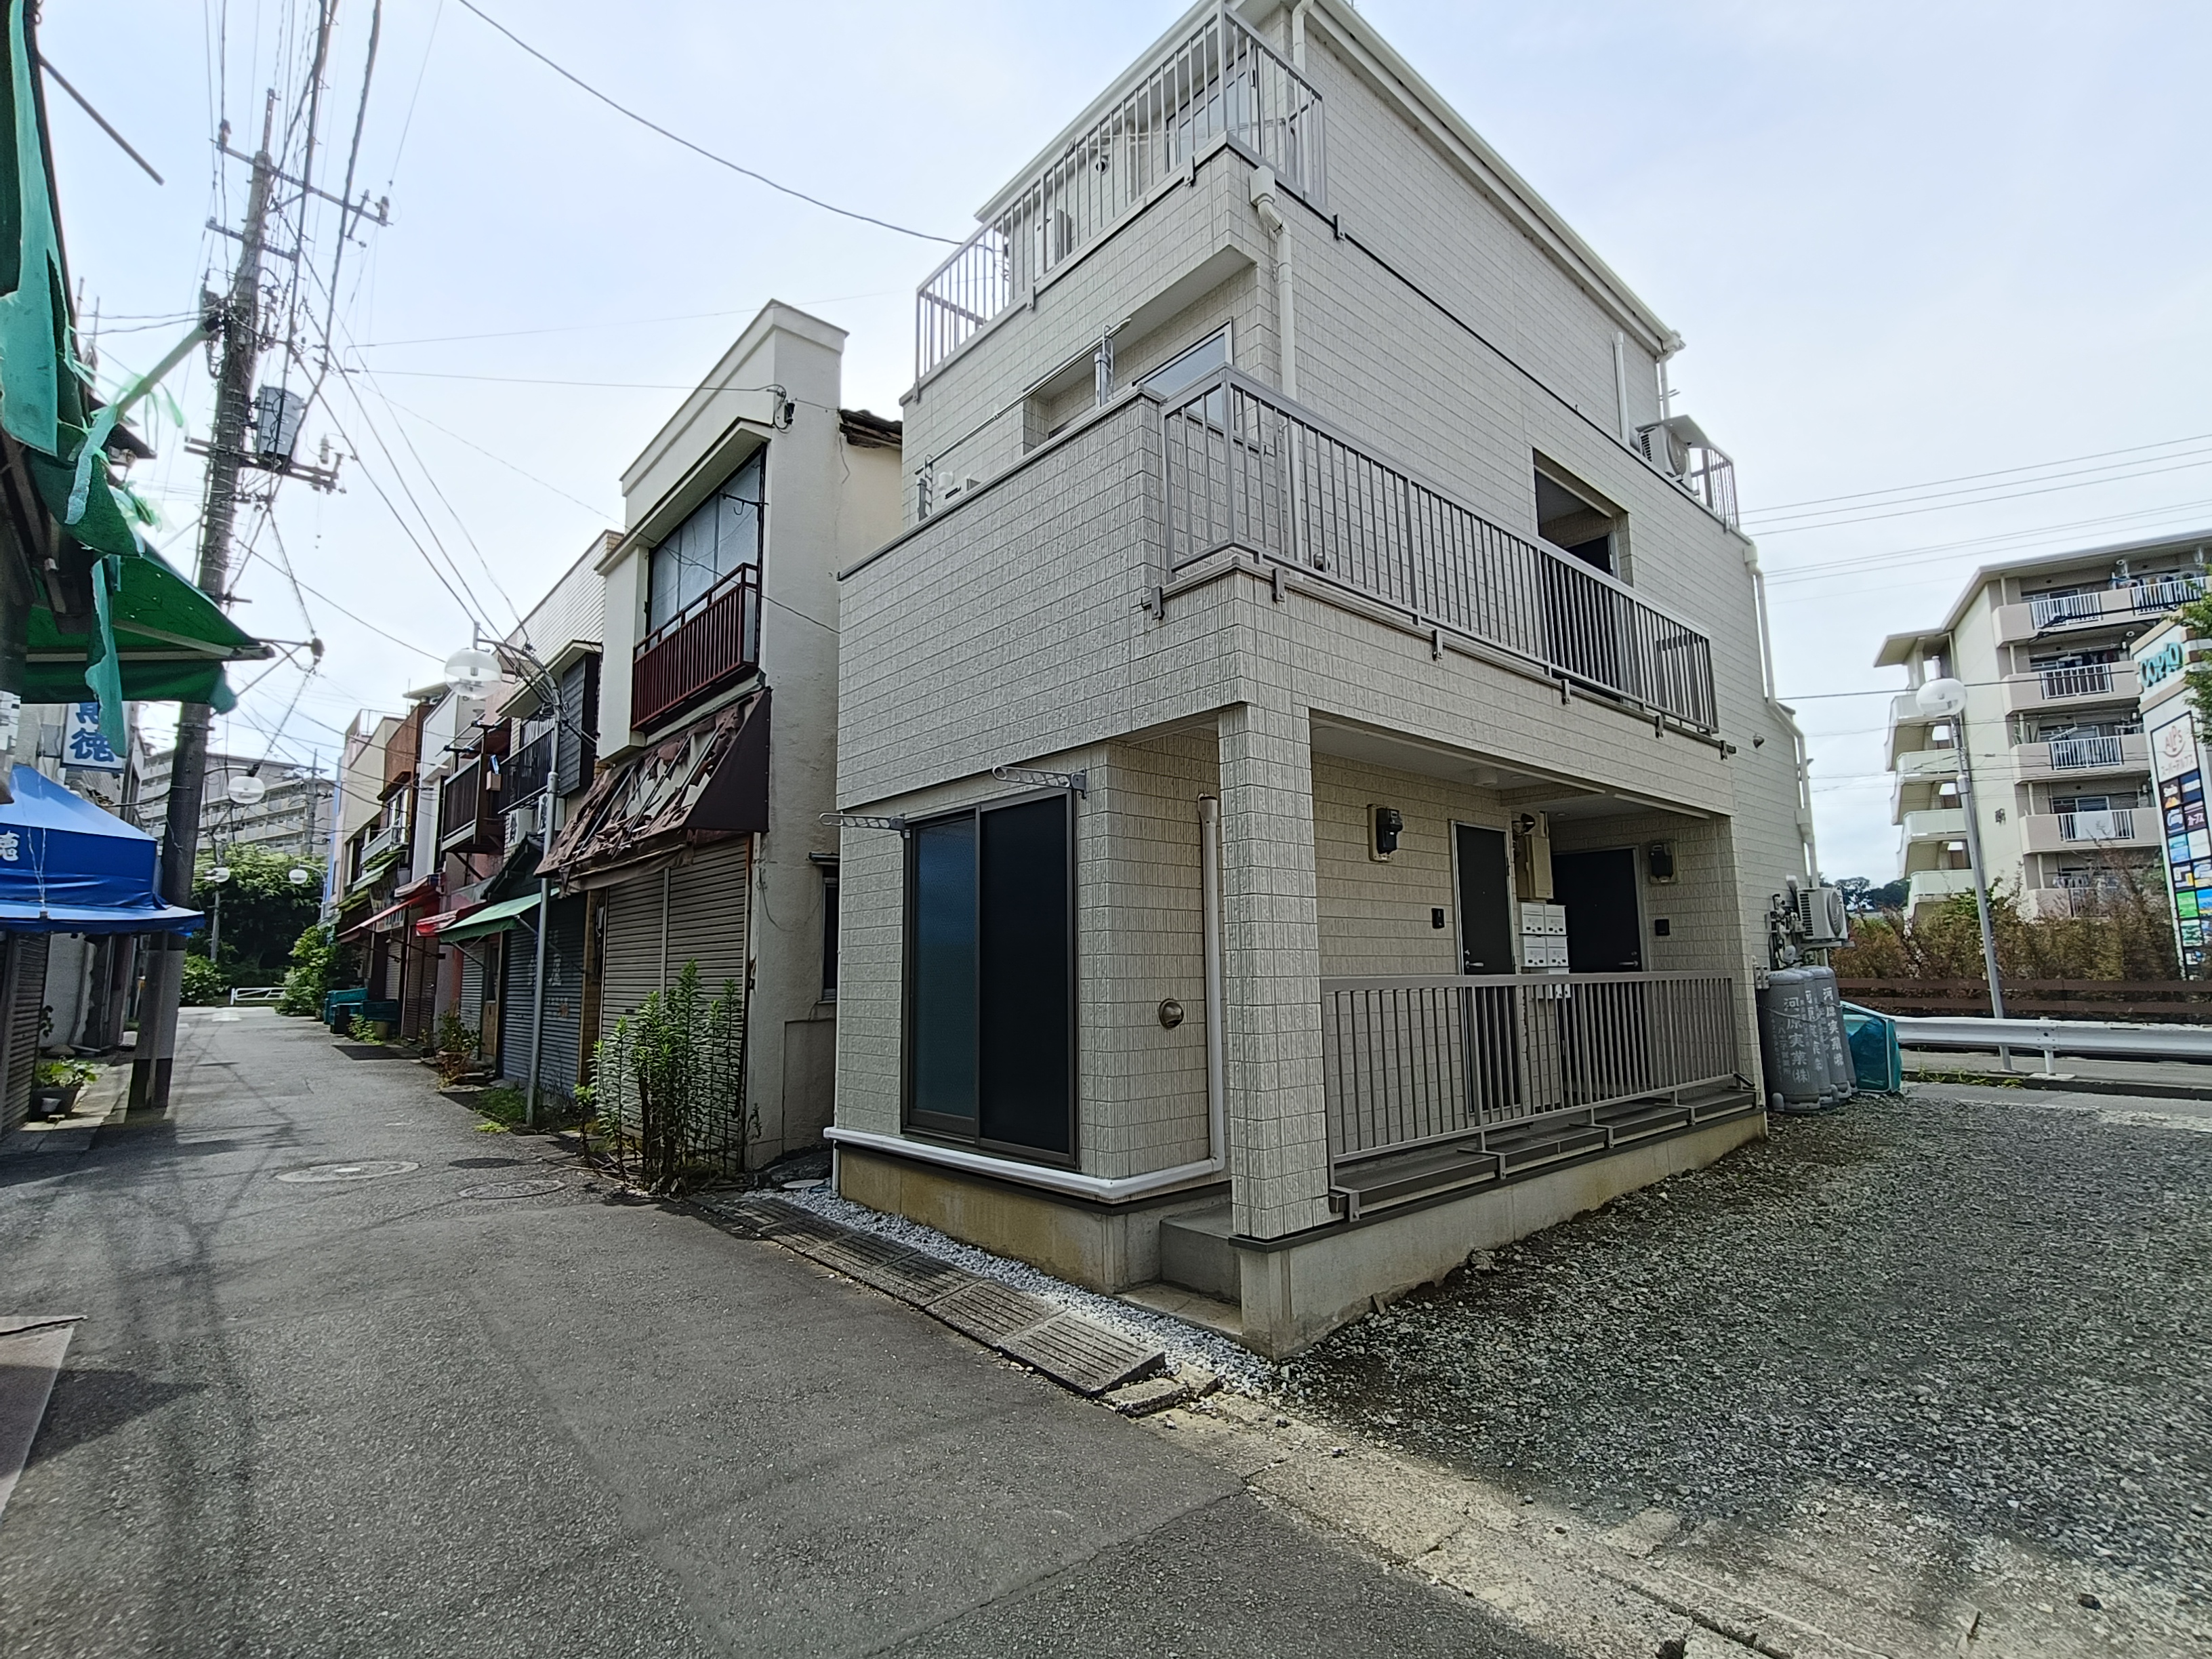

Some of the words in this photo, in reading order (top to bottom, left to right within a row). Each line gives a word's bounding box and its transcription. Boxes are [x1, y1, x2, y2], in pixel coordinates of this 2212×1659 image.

[2160, 754, 2194, 777] スーパーアルプス
